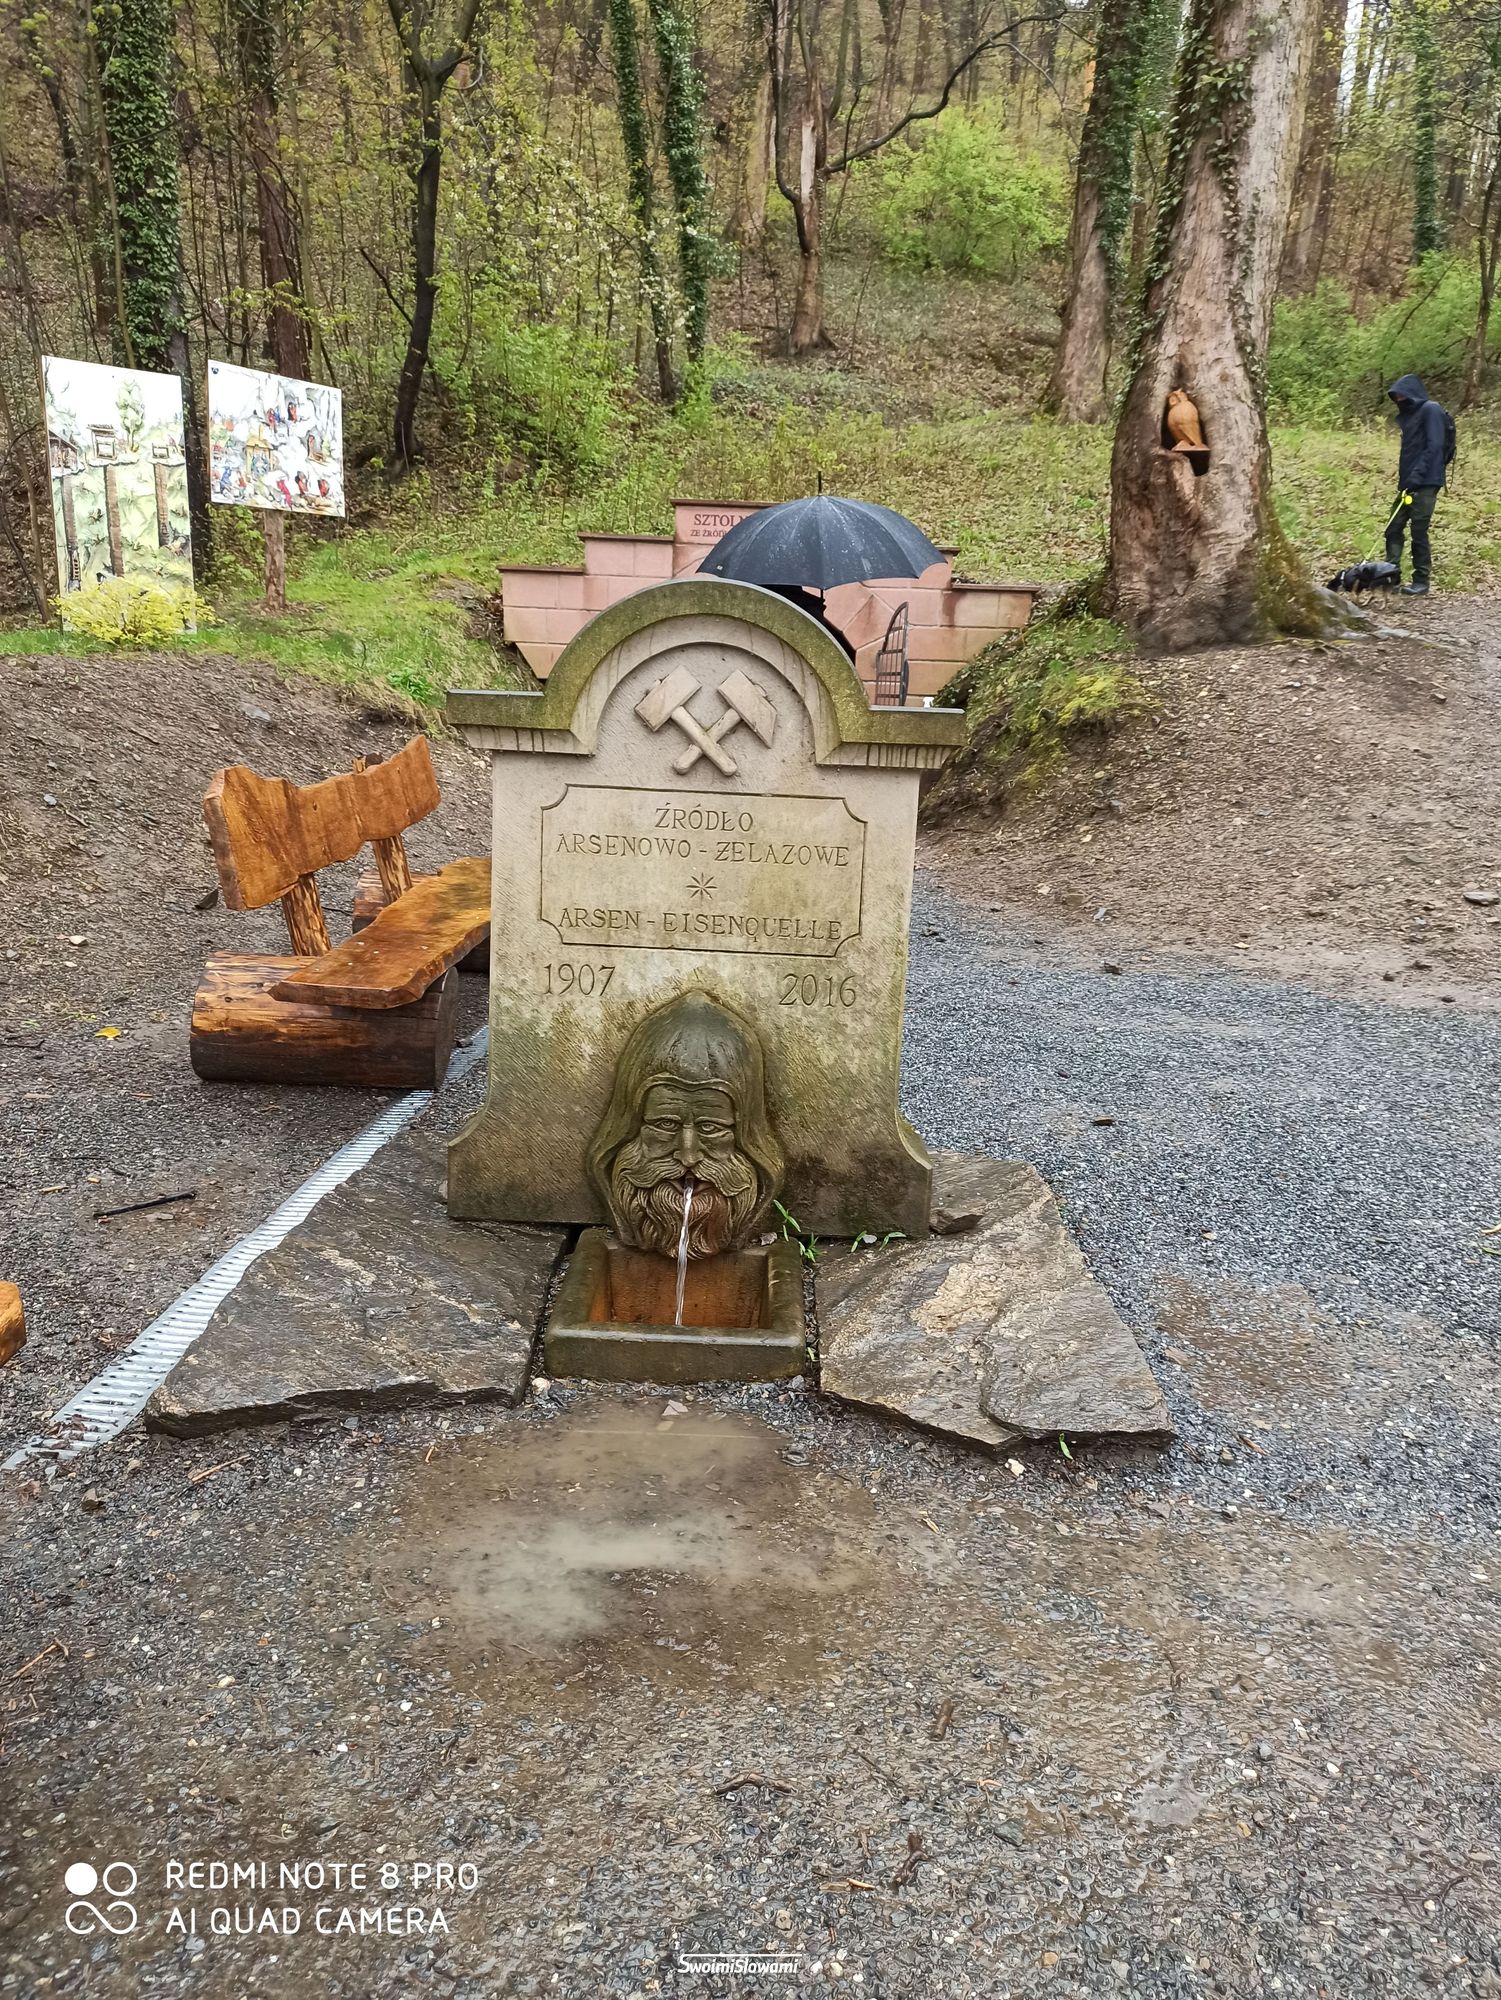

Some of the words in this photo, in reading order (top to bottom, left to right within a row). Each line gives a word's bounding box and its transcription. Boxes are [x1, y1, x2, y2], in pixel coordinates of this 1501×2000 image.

[694, 513, 744, 527] SZTOL
[654, 802, 753, 832] ŹRÓDŁO
[556, 833, 691, 859] ARSENOWO
[558, 907, 641, 931] ARSEN
[662, 912, 843, 942] EISENQUELLE
[543, 963, 615, 997] 1907
[779, 973, 857, 1007] 2016
